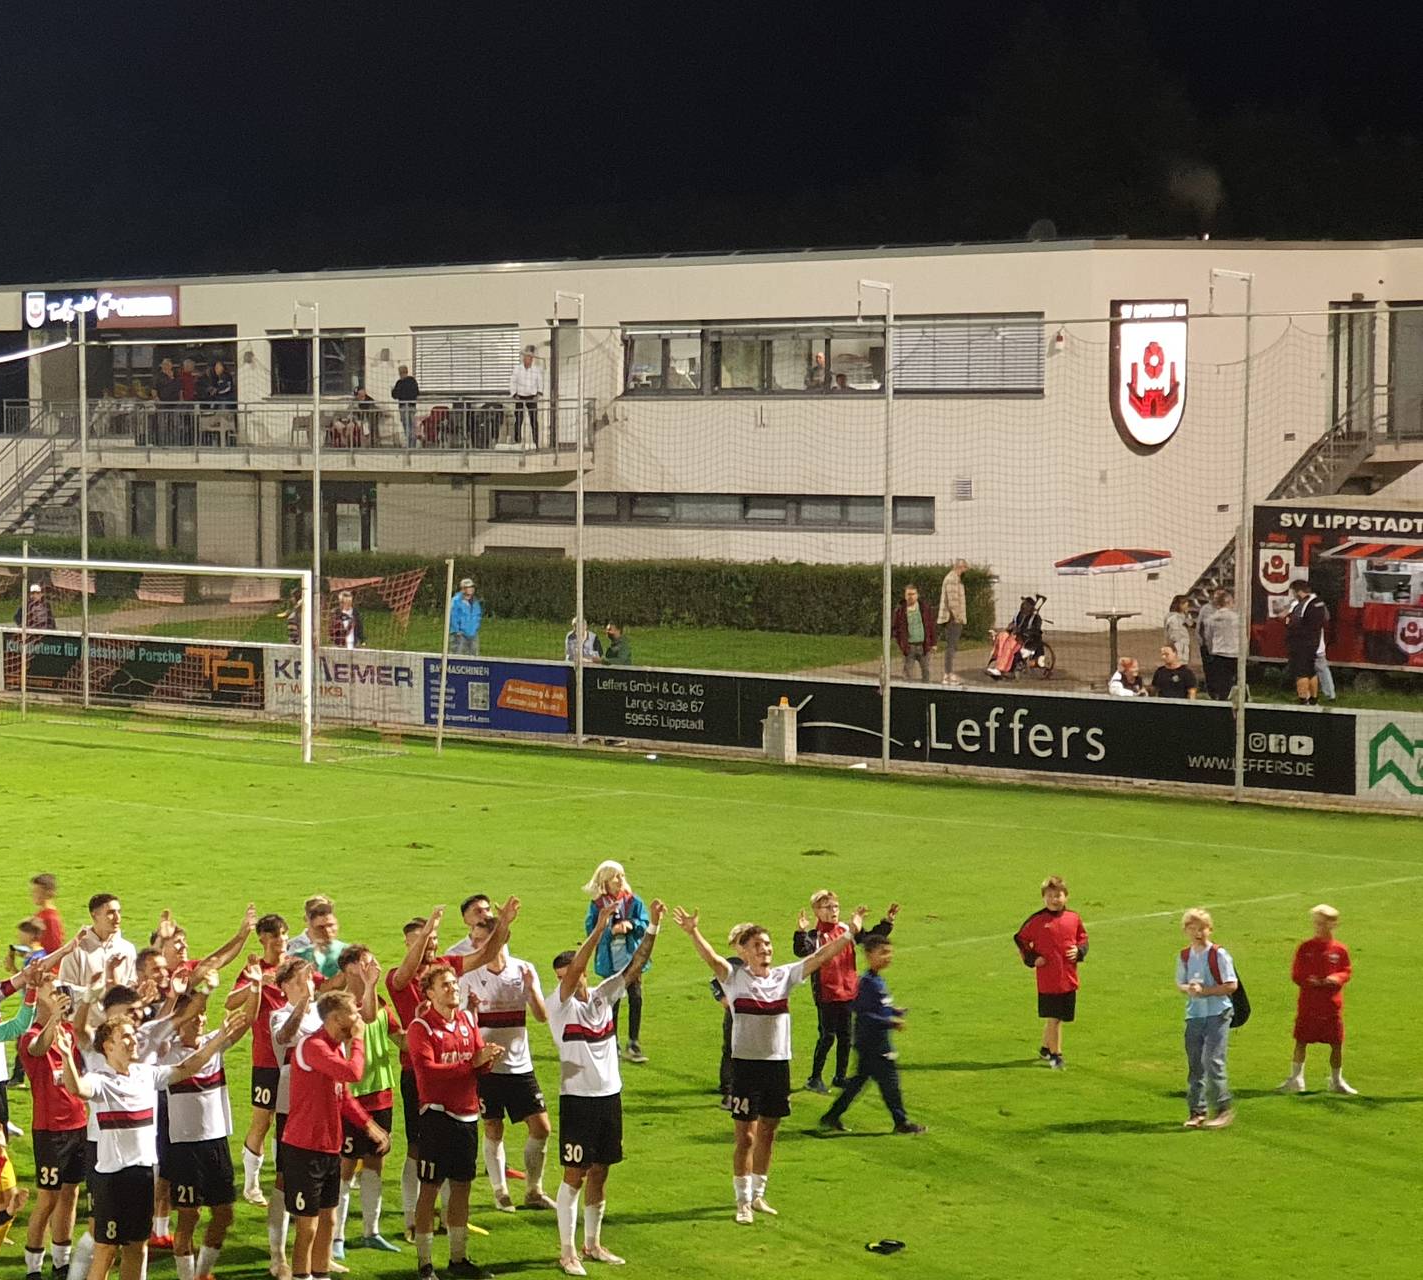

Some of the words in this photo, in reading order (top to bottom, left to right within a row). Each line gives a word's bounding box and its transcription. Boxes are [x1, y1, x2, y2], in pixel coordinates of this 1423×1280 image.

[1280, 512, 1307, 528] SV
[1312, 514, 1423, 533] LIPPSTADT
[6, 640, 61, 656] Kopetenz
[64, 643, 78, 656] für
[139, 648, 182, 664] Porsche
[430, 664, 489, 676] BAMASCHINEN
[597, 679, 628, 692] Leffers
[629, 680, 660, 693] GmbH
[662, 684, 669, 694] &
[689, 684, 704, 696] KG
[625, 697, 654, 712] Lange
[656, 699, 689, 713] Straße
[690, 701, 705, 713] 67
[625, 712, 659, 727] 59555
[660, 716, 705, 731] Lippstadt
[1187, 754, 1315, 777] WWW.LEFFERS.DE
[254, 1086, 271, 1105] 20
[733, 1097, 749, 1114] 24
[564, 1143, 583, 1163] 30
[40, 1167, 59, 1186] 35
[420, 1160, 435, 1180] 11
[177, 1185, 194, 1203] 21
[295, 1192, 305, 1211] 6
[106, 1220, 117, 1240] 8
